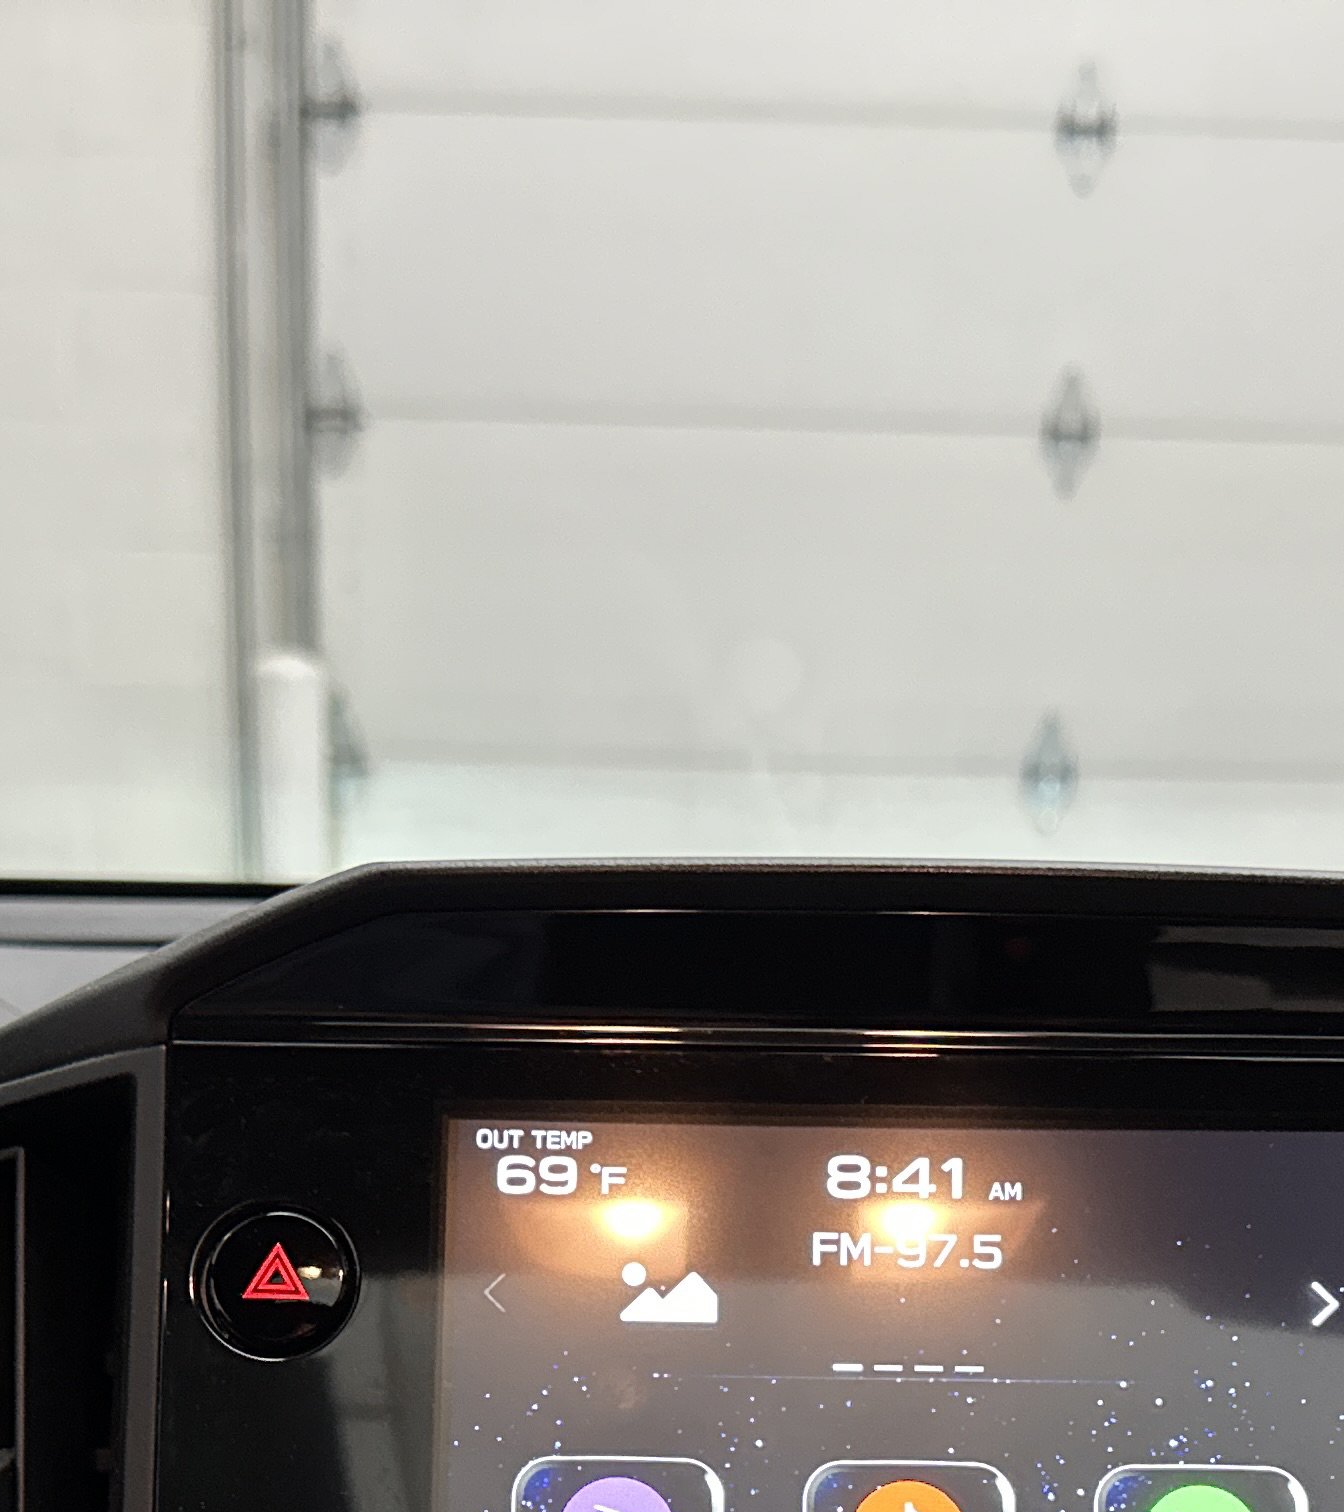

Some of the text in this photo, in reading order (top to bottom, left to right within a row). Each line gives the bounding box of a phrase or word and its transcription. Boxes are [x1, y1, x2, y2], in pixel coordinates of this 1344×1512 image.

[476, 1128, 593, 1150] OUT TEMP
[496, 1154, 578, 1196] 69
[826, 1154, 1023, 1201] 8:41 AM
[812, 1231, 1004, 1270] FM-97.5
